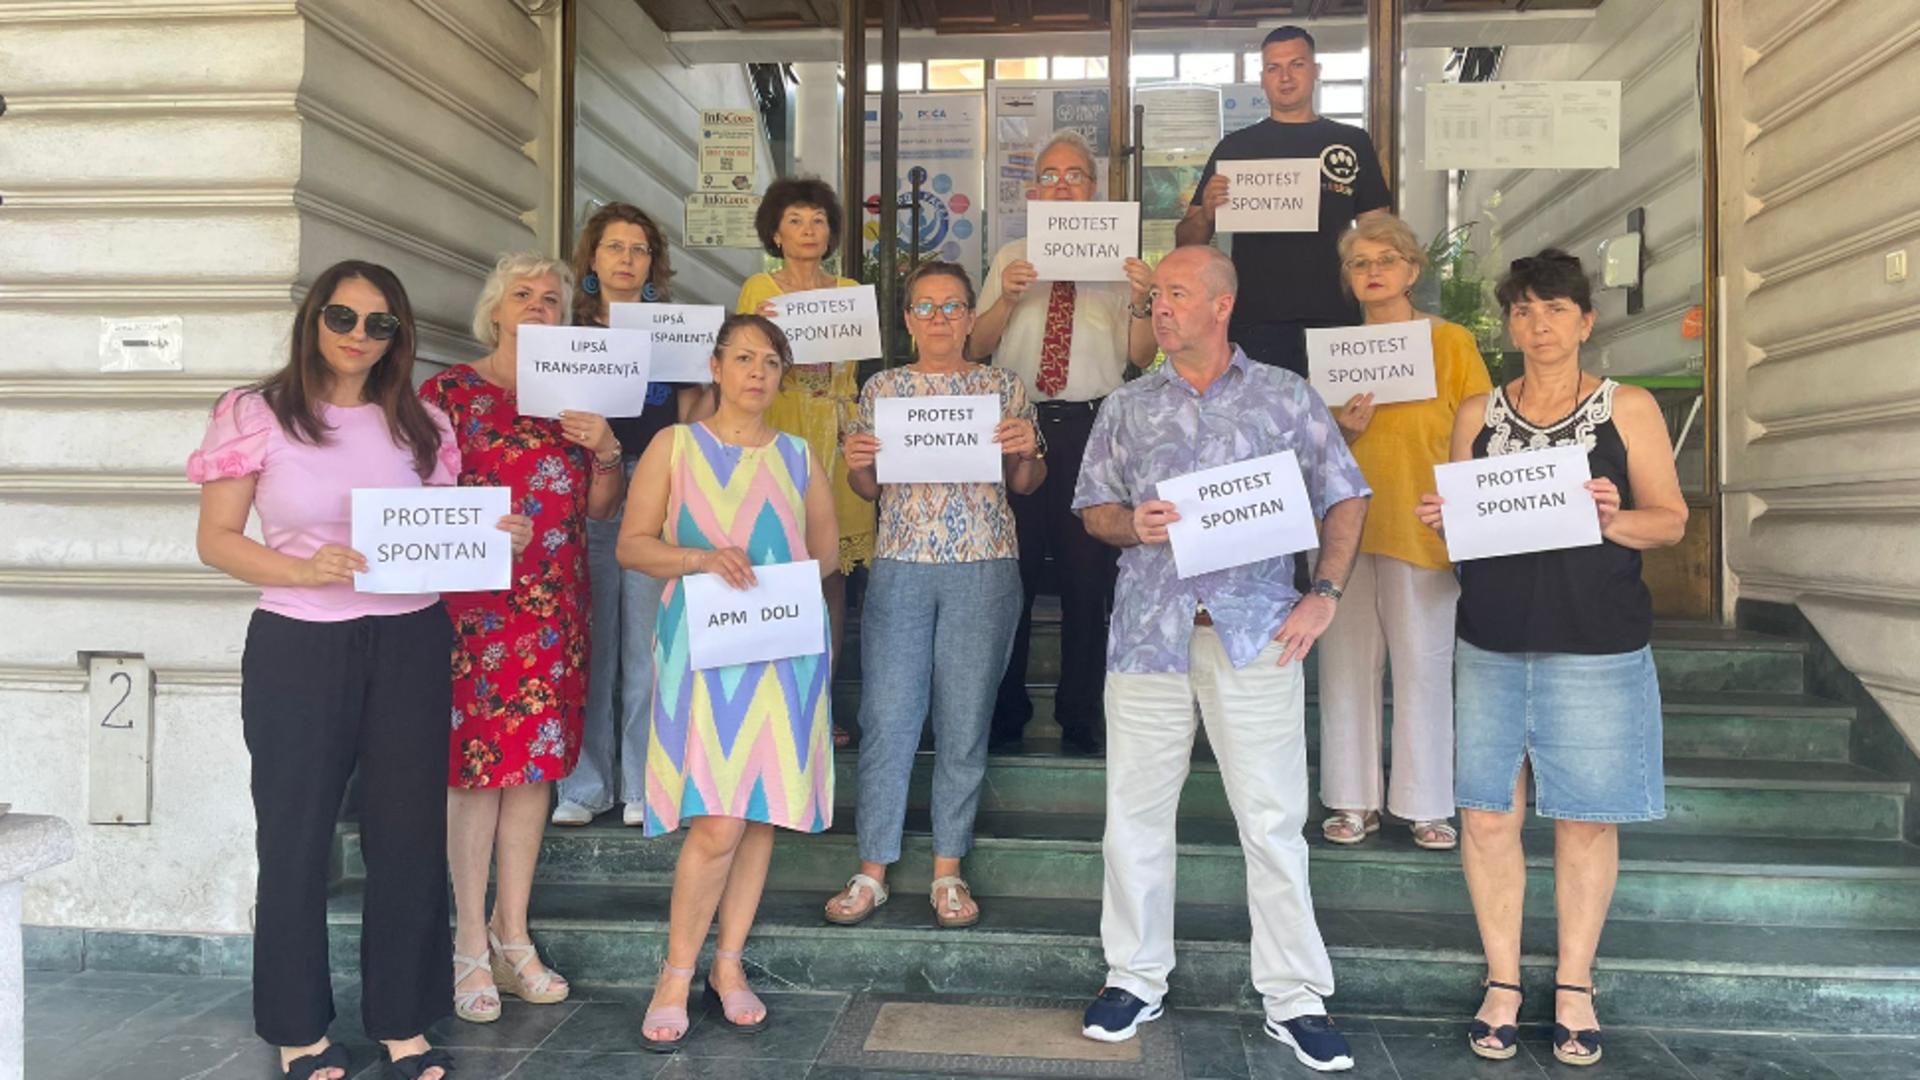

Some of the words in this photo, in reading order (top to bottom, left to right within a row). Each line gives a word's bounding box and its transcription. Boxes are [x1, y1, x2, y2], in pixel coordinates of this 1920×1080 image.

[1236, 172, 1301, 186] PROTEST
[1231, 197, 1303, 211] SPONTAN
[1048, 216, 1118, 231] PROTEST
[1044, 242, 1119, 258] SPONTAN
[786, 299, 856, 316] PROTEST
[785, 323, 862, 341] SPONTAN
[571, 339, 608, 353] LIPSĂ
[1330, 336, 1408, 356] PROTEST
[1328, 364, 1415, 383] SPONTAN
[908, 408, 974, 422] PROTEST
[904, 432, 978, 447] SPONTAN
[1476, 464, 1557, 488] PROTEST
[1199, 472, 1271, 501] PROTEST
[1200, 498, 1284, 529] SPONTAN
[1476, 492, 1567, 517] SPONTAN
[383, 508, 482, 526] PROTEST
[377, 542, 486, 562] SPONTAN
[708, 611, 747, 627] APM
[761, 604, 799, 621] DOLJ
[101, 672, 133, 729] 2
